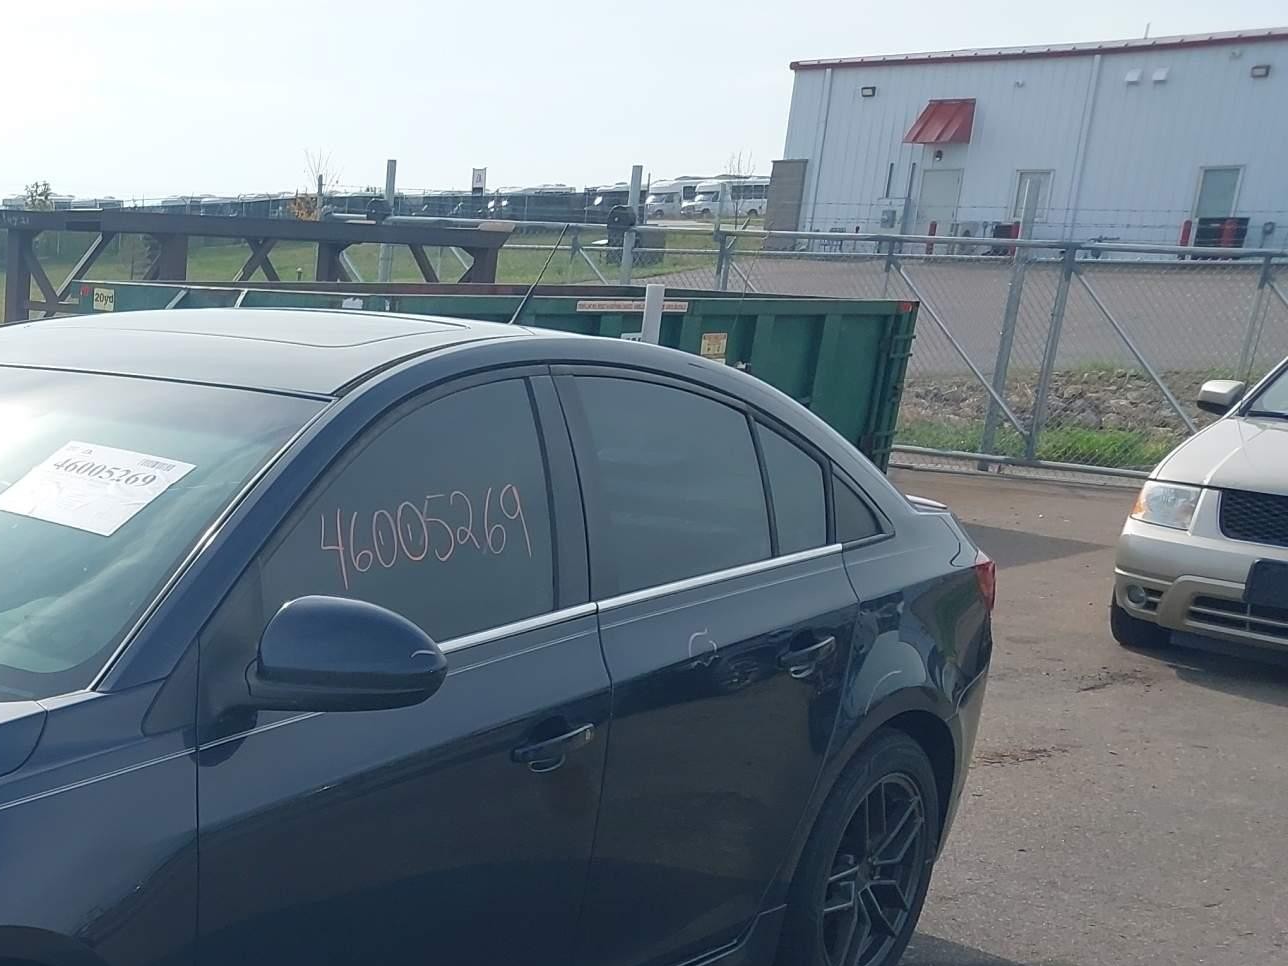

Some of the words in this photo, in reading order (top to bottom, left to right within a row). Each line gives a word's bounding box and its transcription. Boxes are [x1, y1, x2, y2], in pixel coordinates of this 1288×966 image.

[95, 292, 114, 305] 20yd
[54, 458, 156, 487] 46005269
[321, 484, 531, 590] 46005269
